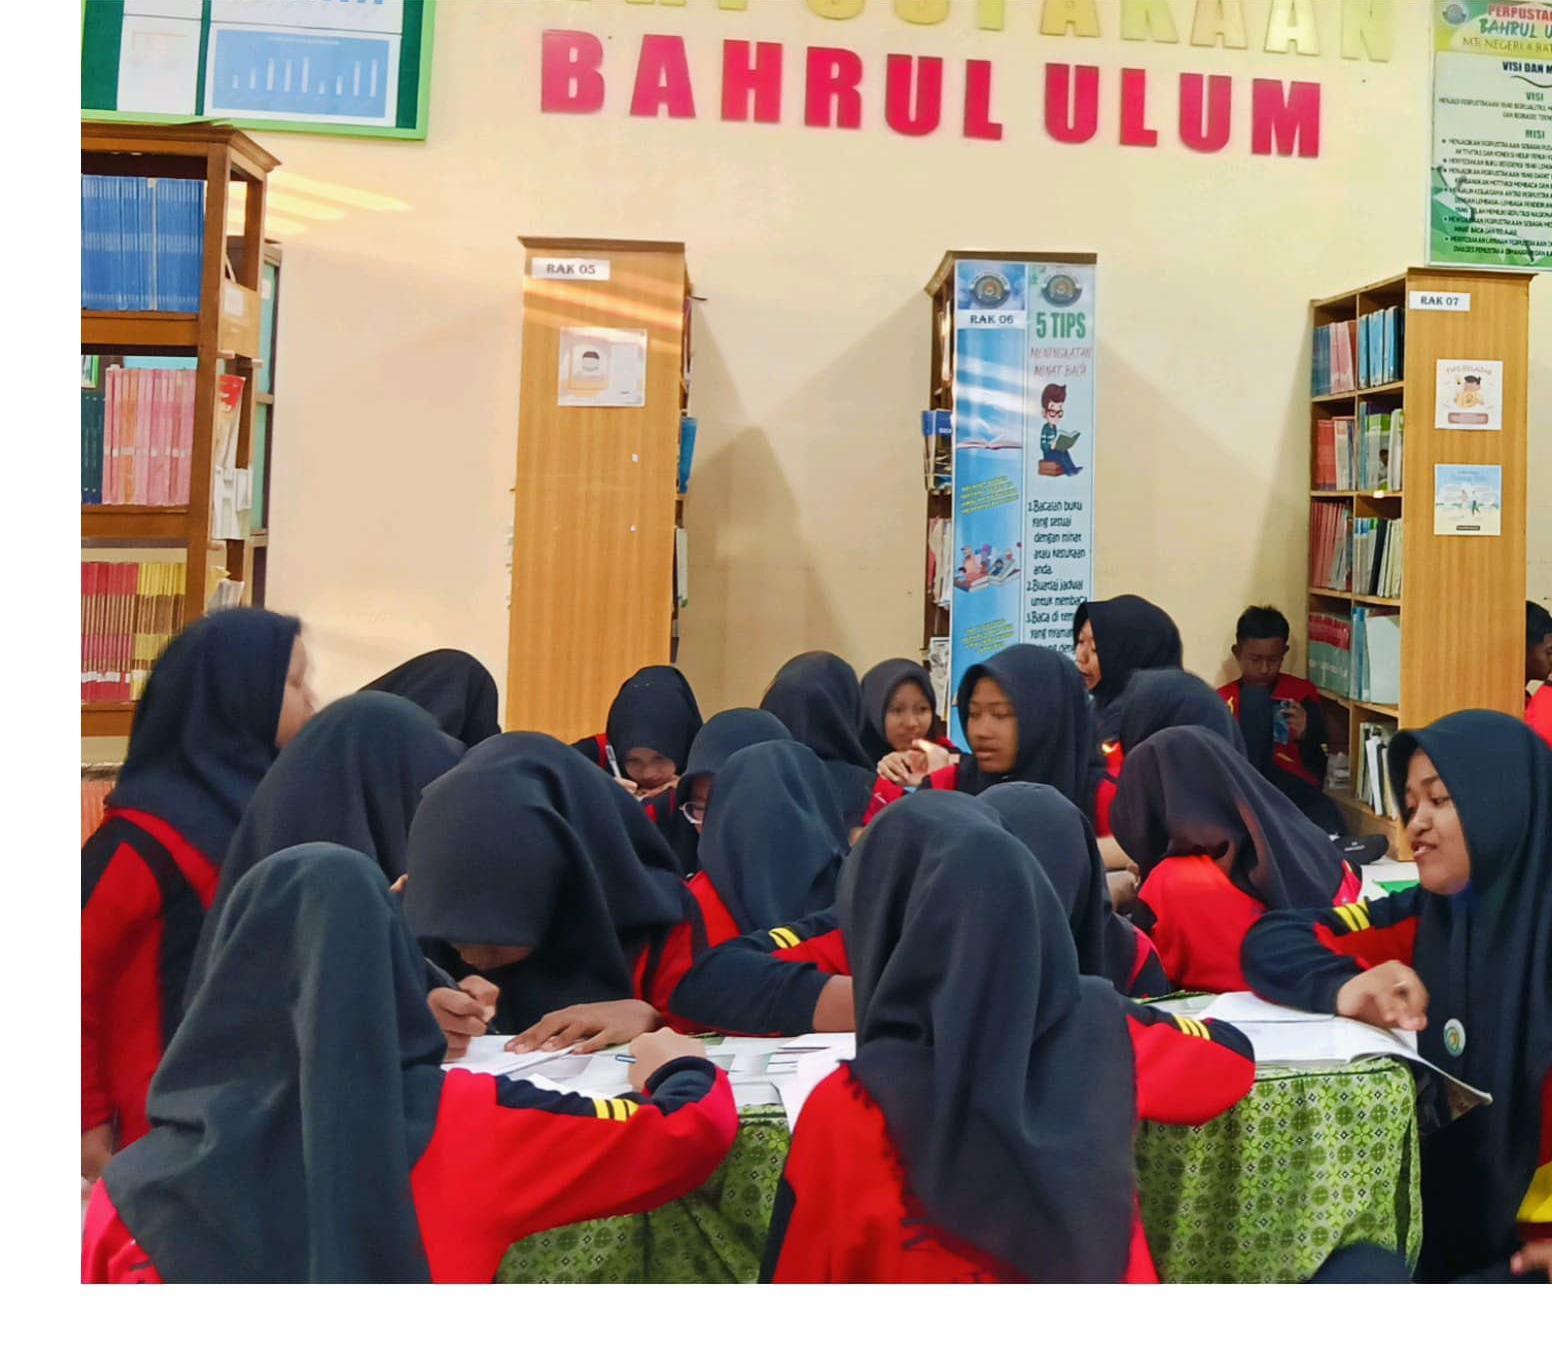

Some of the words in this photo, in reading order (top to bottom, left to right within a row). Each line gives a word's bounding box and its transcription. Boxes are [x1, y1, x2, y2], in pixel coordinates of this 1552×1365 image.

[1479, 18, 1537, 39] BAHRUL
[1484, 38, 1522, 51] NEGERI
[1502, 61, 1522, 71] VISI
[1523, 62, 1544, 74] DAN
[541, 29, 1003, 142] BAHRUL
[1044, 61, 1321, 159] ULUM
[1525, 92, 1544, 101] VISI
[1525, 129, 1545, 139] MISI
[546, 263, 575, 275] RAK
[578, 264, 597, 275] 05
[1420, 295, 1444, 306] RAK
[1446, 296, 1460, 307] 07
[970, 315, 996, 325] RAK
[998, 314, 1014, 324] 06
[1035, 312, 1048, 339] 5
[1050, 312, 1087, 339] TIPS
